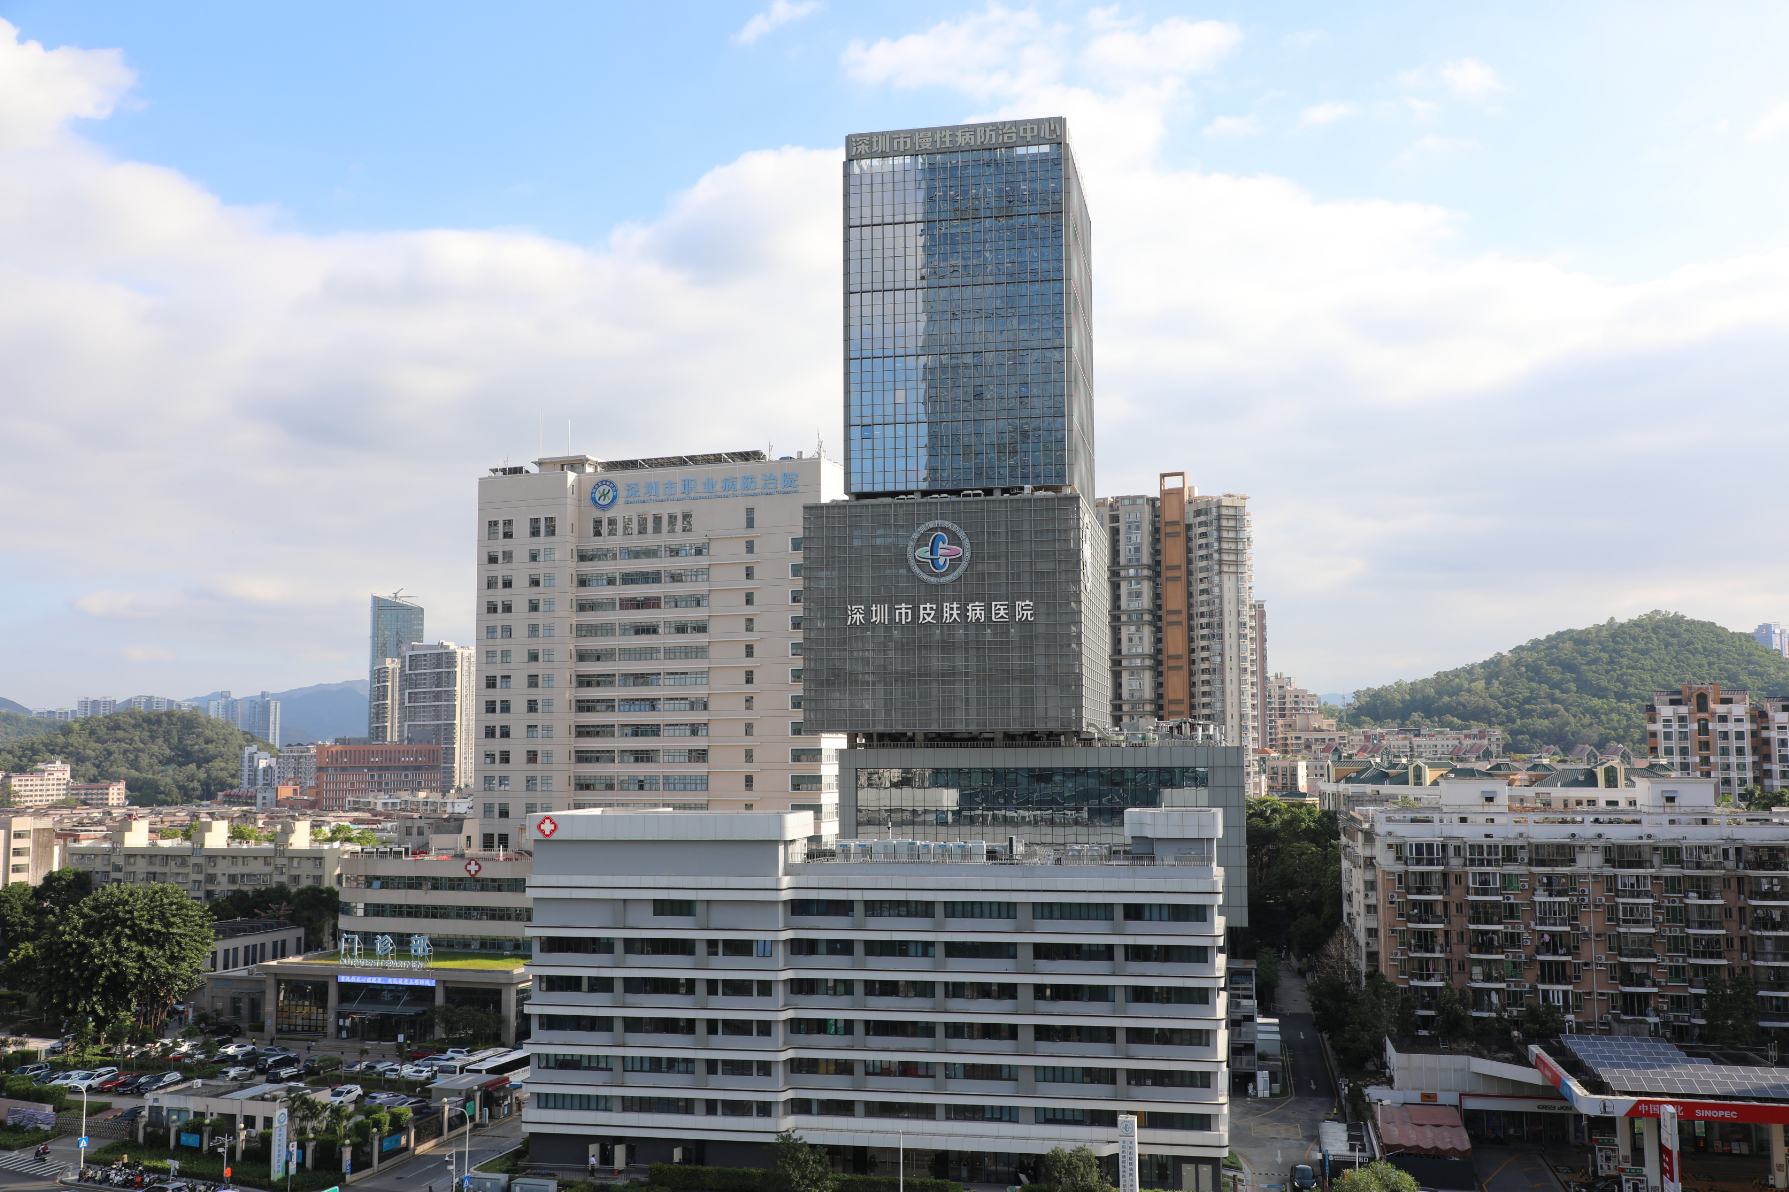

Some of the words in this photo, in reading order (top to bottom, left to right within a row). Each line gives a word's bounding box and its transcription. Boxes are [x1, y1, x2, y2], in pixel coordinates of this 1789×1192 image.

[851, 119, 1061, 156] 深圳市慢性病防治中心
[624, 471, 799, 499] 深圳市职业病防治院
[846, 600, 1034, 626] 深圳市皮肤病医院
[340, 933, 428, 956] 门诊部
[1638, 1103, 1684, 1117] 中国化
[1695, 1109, 1738, 1119] SINOPEC
